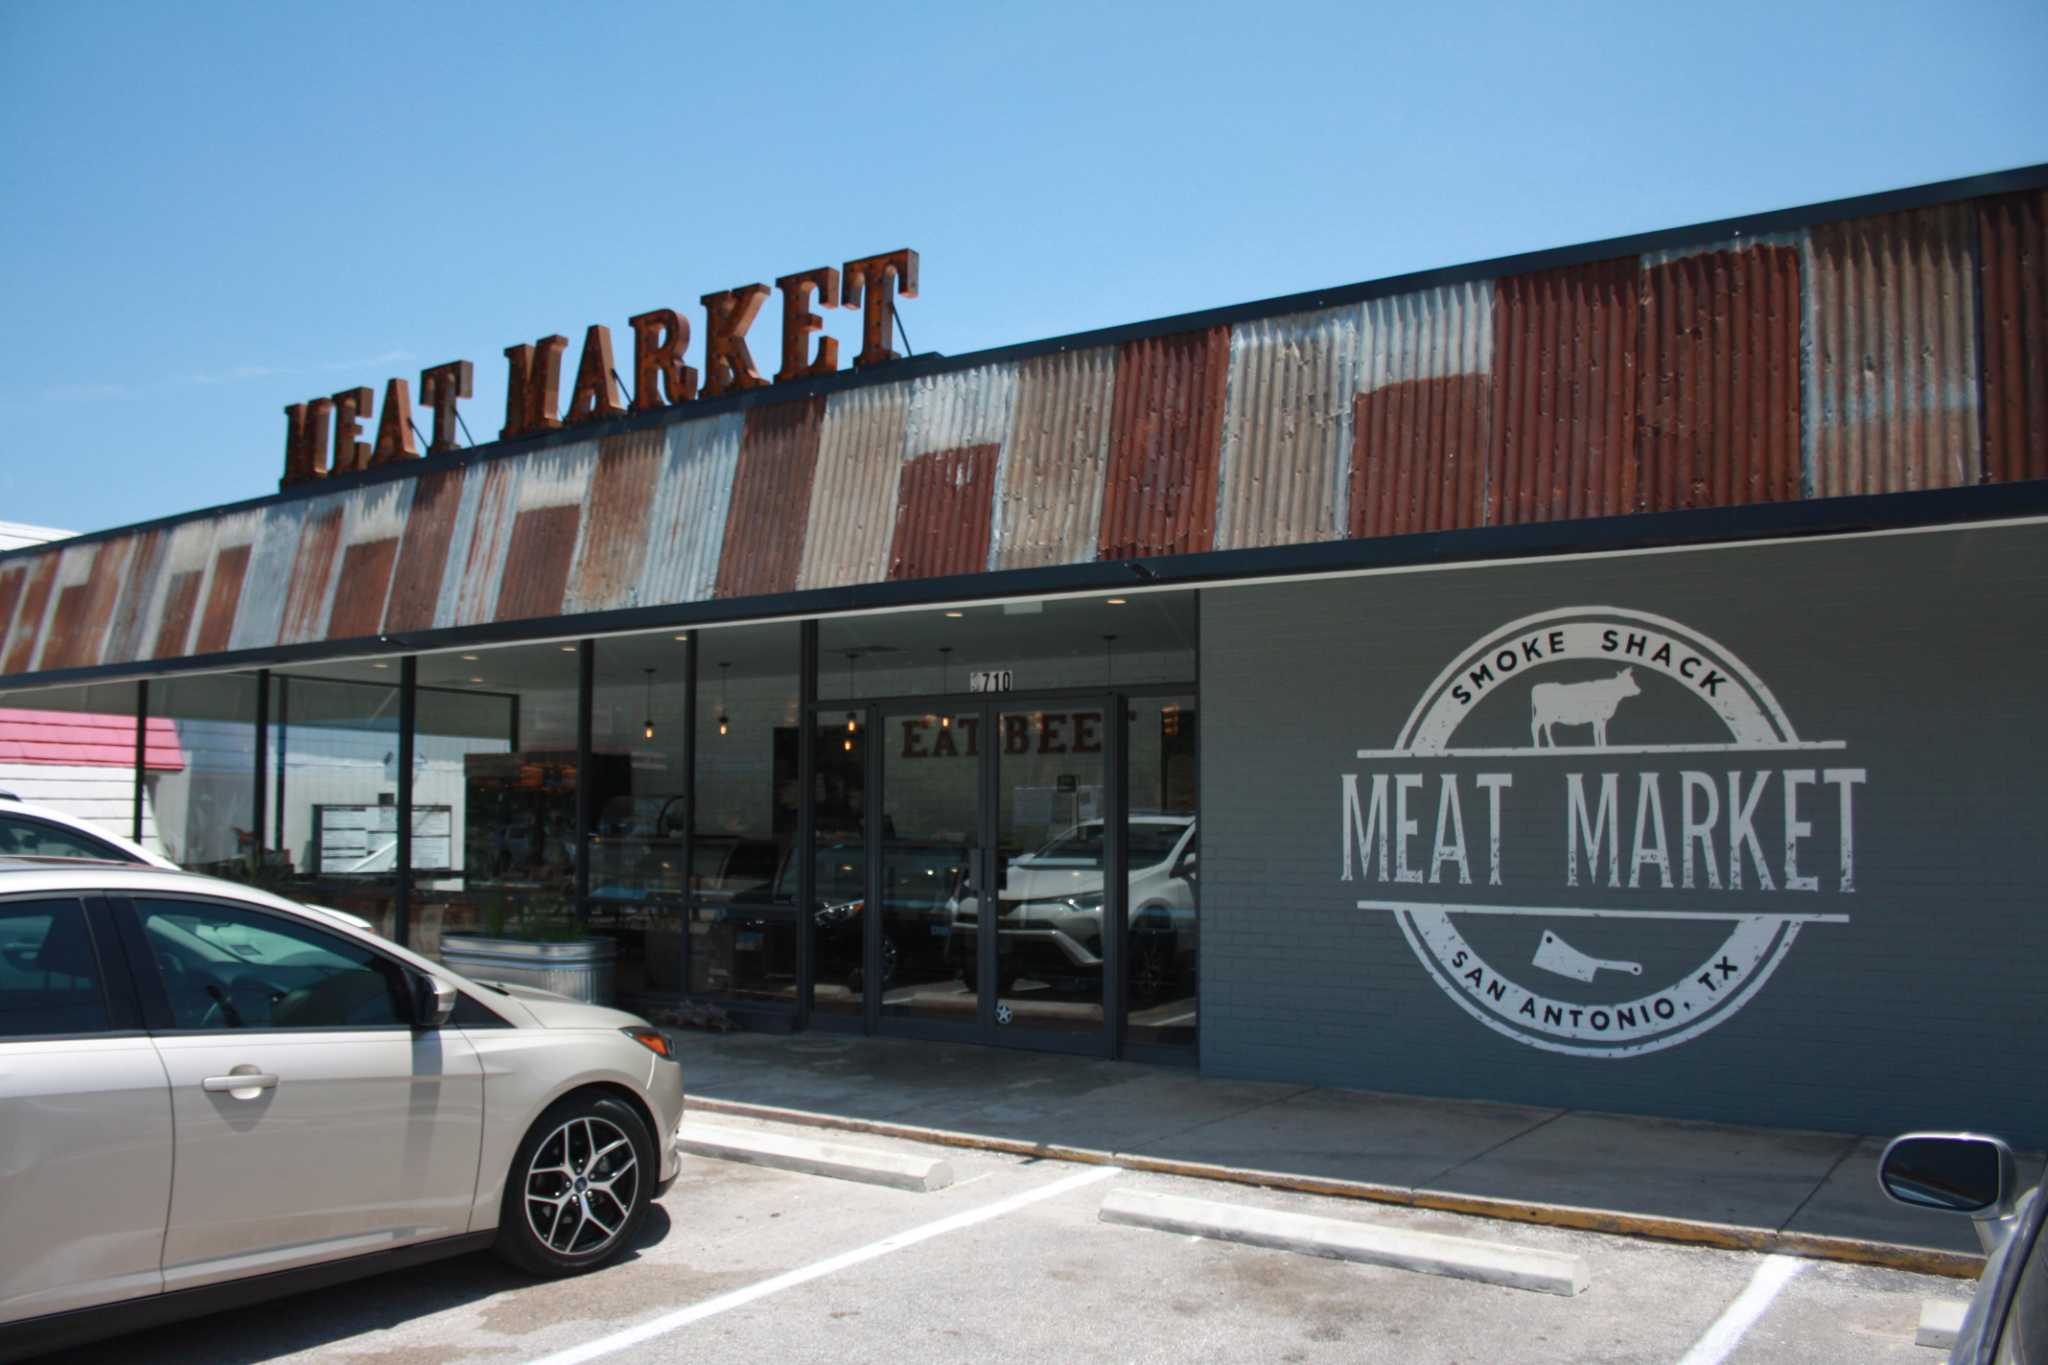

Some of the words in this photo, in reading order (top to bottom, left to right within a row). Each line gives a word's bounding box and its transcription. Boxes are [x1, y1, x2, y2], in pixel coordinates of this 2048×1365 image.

[280, 360, 473, 489] MEAT
[499, 248, 919, 438] MARKET
[971, 671, 1011, 692] 710
[1452, 631, 1565, 705] SMOKE
[1601, 629, 1727, 697] SHACK
[901, 715, 979, 758] EAT
[1003, 712, 1137, 754] BEE
[1340, 772, 1513, 885] MEAT
[1565, 768, 1867, 893] MARKET
[1452, 950, 1507, 1001] SAN
[1519, 997, 1691, 1031] ANTONIO,
[1698, 955, 1738, 992] TX
